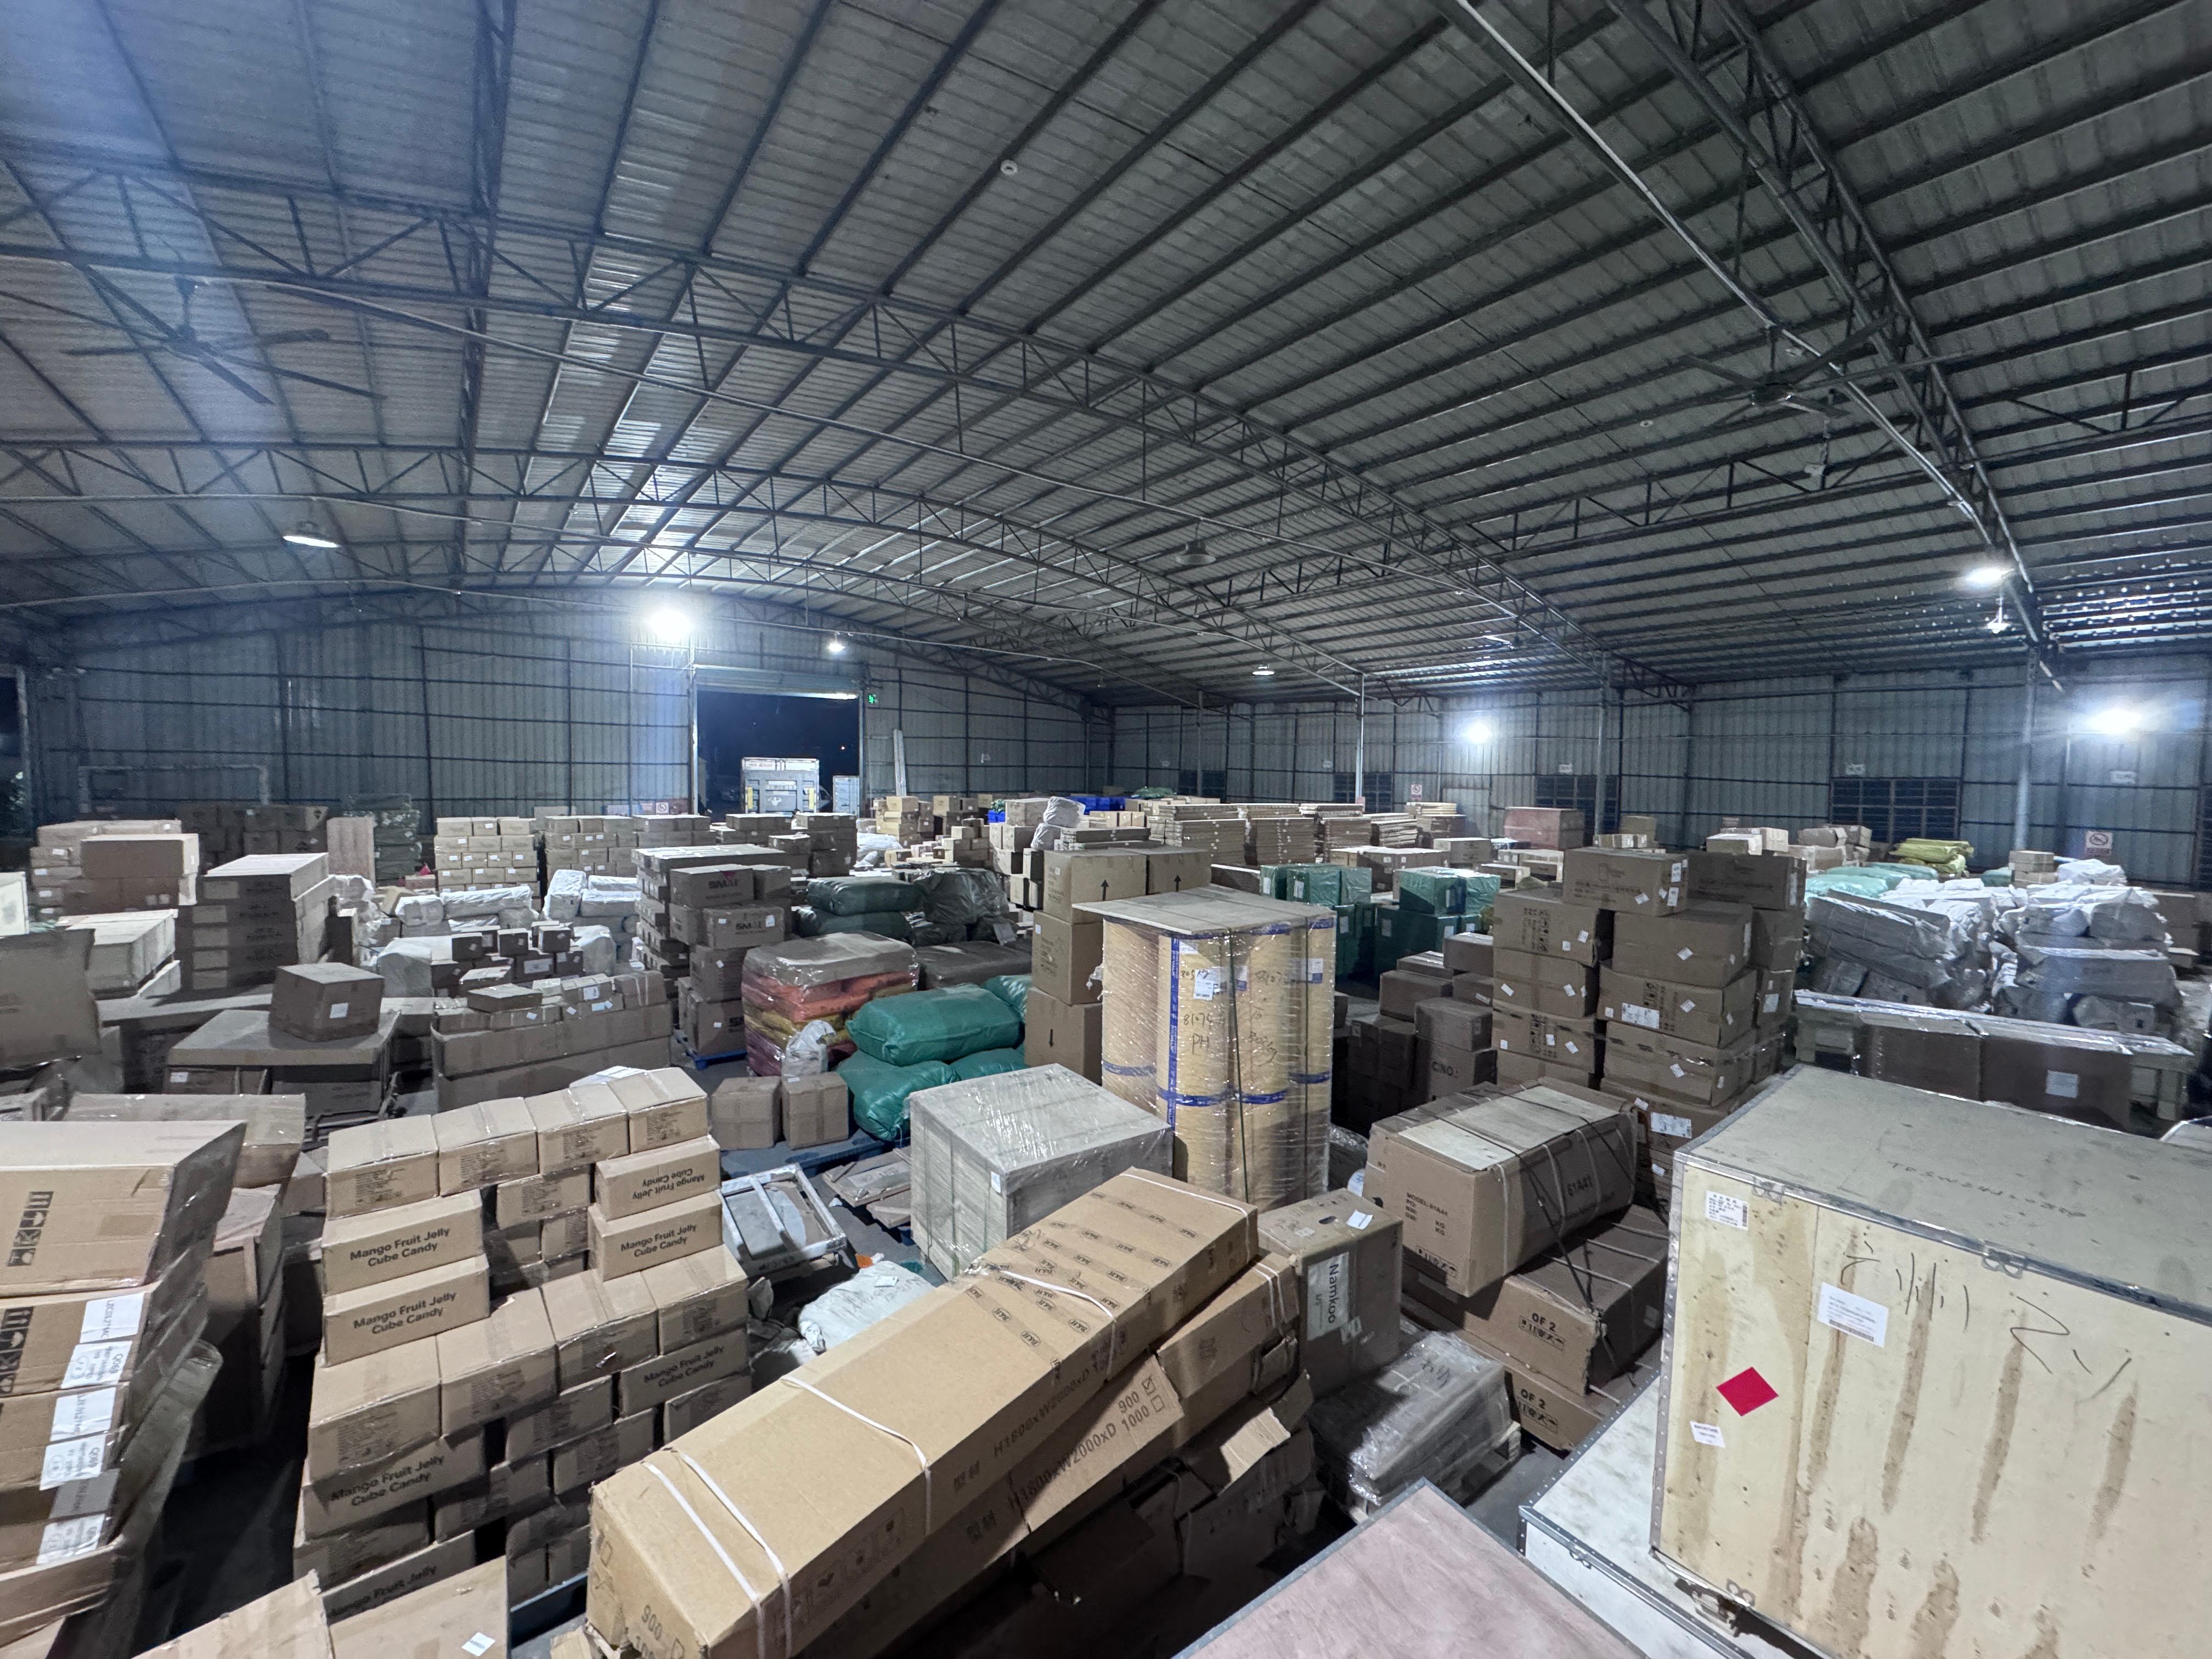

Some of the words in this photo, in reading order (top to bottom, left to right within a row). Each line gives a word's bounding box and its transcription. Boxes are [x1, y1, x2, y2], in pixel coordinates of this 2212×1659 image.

[642, 1175, 669, 1187] Candy
[672, 1168, 693, 1179] Cube
[676, 1174, 704, 1187] Mango
[633, 1189, 653, 1199] Jelly
[655, 1182, 674, 1194] Fruit
[350, 1244, 392, 1260] Mango
[394, 1234, 421, 1249] Fruit
[424, 1228, 450, 1240] Jelly
[620, 1238, 652, 1251] Mango
[654, 1229, 675, 1242] Fruit
[676, 1224, 697, 1235] Jelly
[634, 1246, 657, 1257] Cube
[659, 1237, 687, 1249] Candy
[368, 1253, 399, 1267] Cube
[402, 1243, 437, 1257] Candy
[1328, 1263, 1339, 1323] Namkoo
[354, 1310, 396, 1328] Mango
[399, 1300, 426, 1315] Fruit
[429, 1292, 456, 1306] Jelly
[371, 1320, 403, 1334] Cube
[407, 1307, 443, 1323] Candy
[1532, 1313, 1546, 1325] OF
[1549, 1322, 1556, 1331] 2
[1118, 1391, 1139, 1413] 900
[1521, 1389, 1535, 1401] OF
[1539, 1399, 1545, 1409] 2
[1121, 1406, 1150, 1431] 1000
[330, 1479, 379, 1501] Mango
[382, 1466, 412, 1482] Fruit
[641, 1604, 663, 1641] 900
